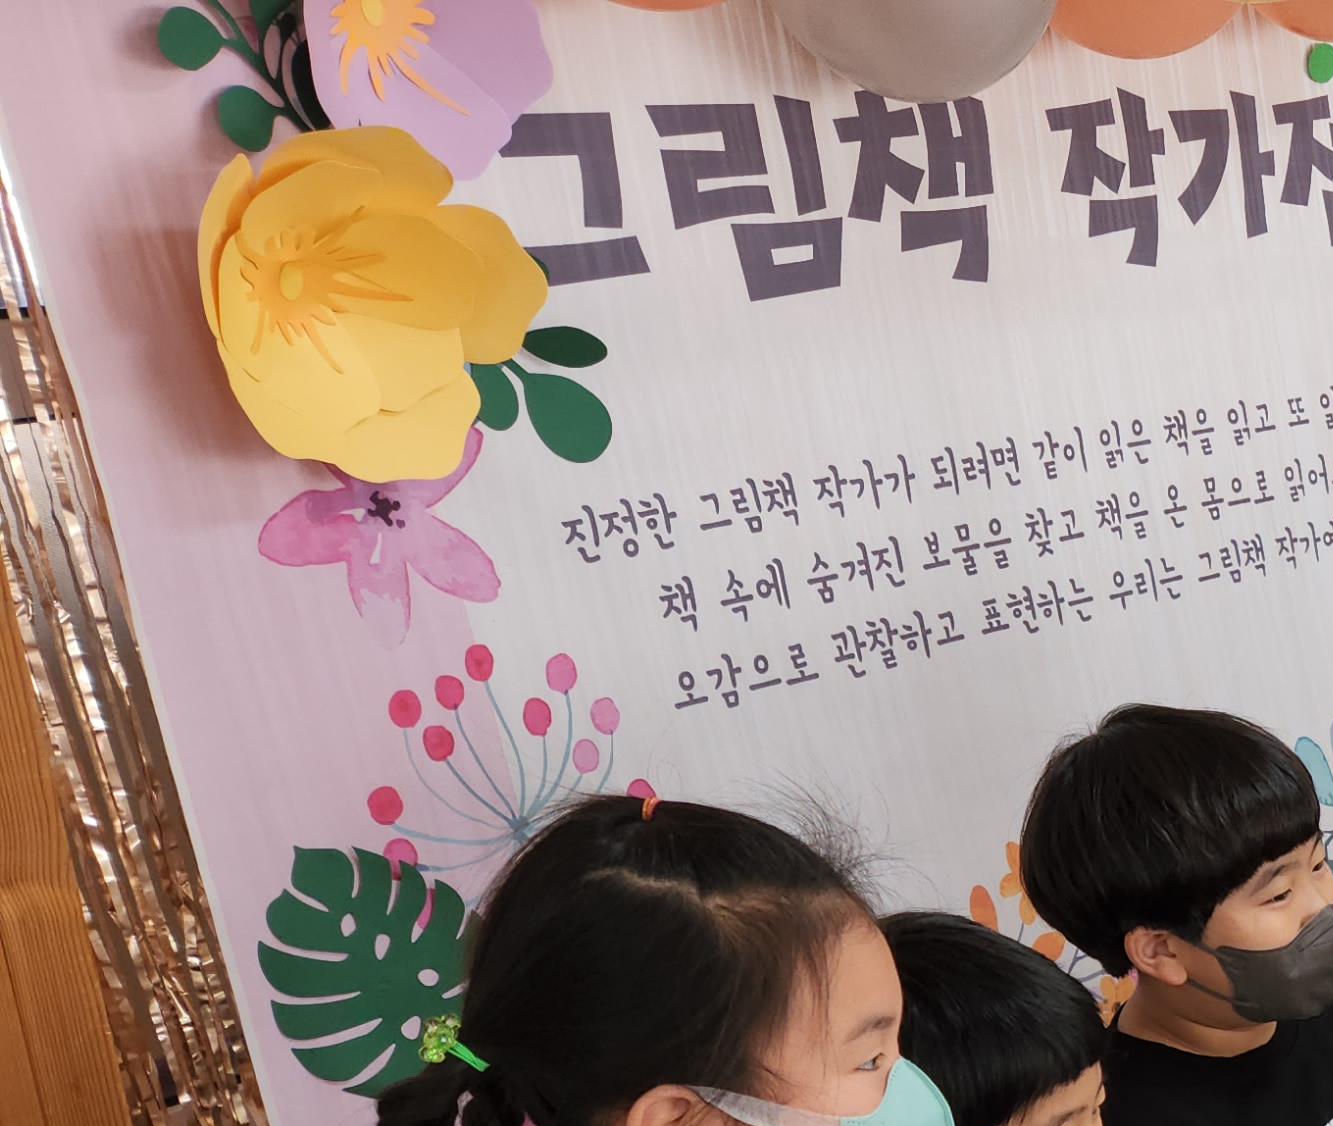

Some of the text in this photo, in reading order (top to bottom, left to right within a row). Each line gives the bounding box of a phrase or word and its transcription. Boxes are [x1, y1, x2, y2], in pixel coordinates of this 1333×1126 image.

[498, 91, 994, 302] 그림책
[561, 493, 678, 563] 진정한
[700, 472, 799, 533] 그림책
[813, 454, 916, 519] 작가가
[930, 437, 1021, 496] 되려면
[1032, 426, 1088, 480] 같이
[1099, 419, 1151, 468] 읽은
[1163, 408, 1215, 456] 책을
[1227, 400, 1277, 446] 읽고
[1287, 397, 1310, 428] 또
[658, 575, 699, 632] 책
[720, 558, 791, 622] 속에
[807, 535, 906, 604] 숨겨진
[922, 517, 1012, 577] 보물을
[1024, 507, 1085, 557] 찾고
[1095, 491, 1149, 540] 책을
[1163, 484, 1188, 529] 온
[1201, 470, 1275, 521] 몸으로
[674, 643, 820, 710] 오감으로
[831, 610, 965, 679] 관찰하고
[981, 578, 1094, 636] 표현하는
[1109, 557, 1184, 611] 우리는
[1198, 534, 1267, 583] 그림책
